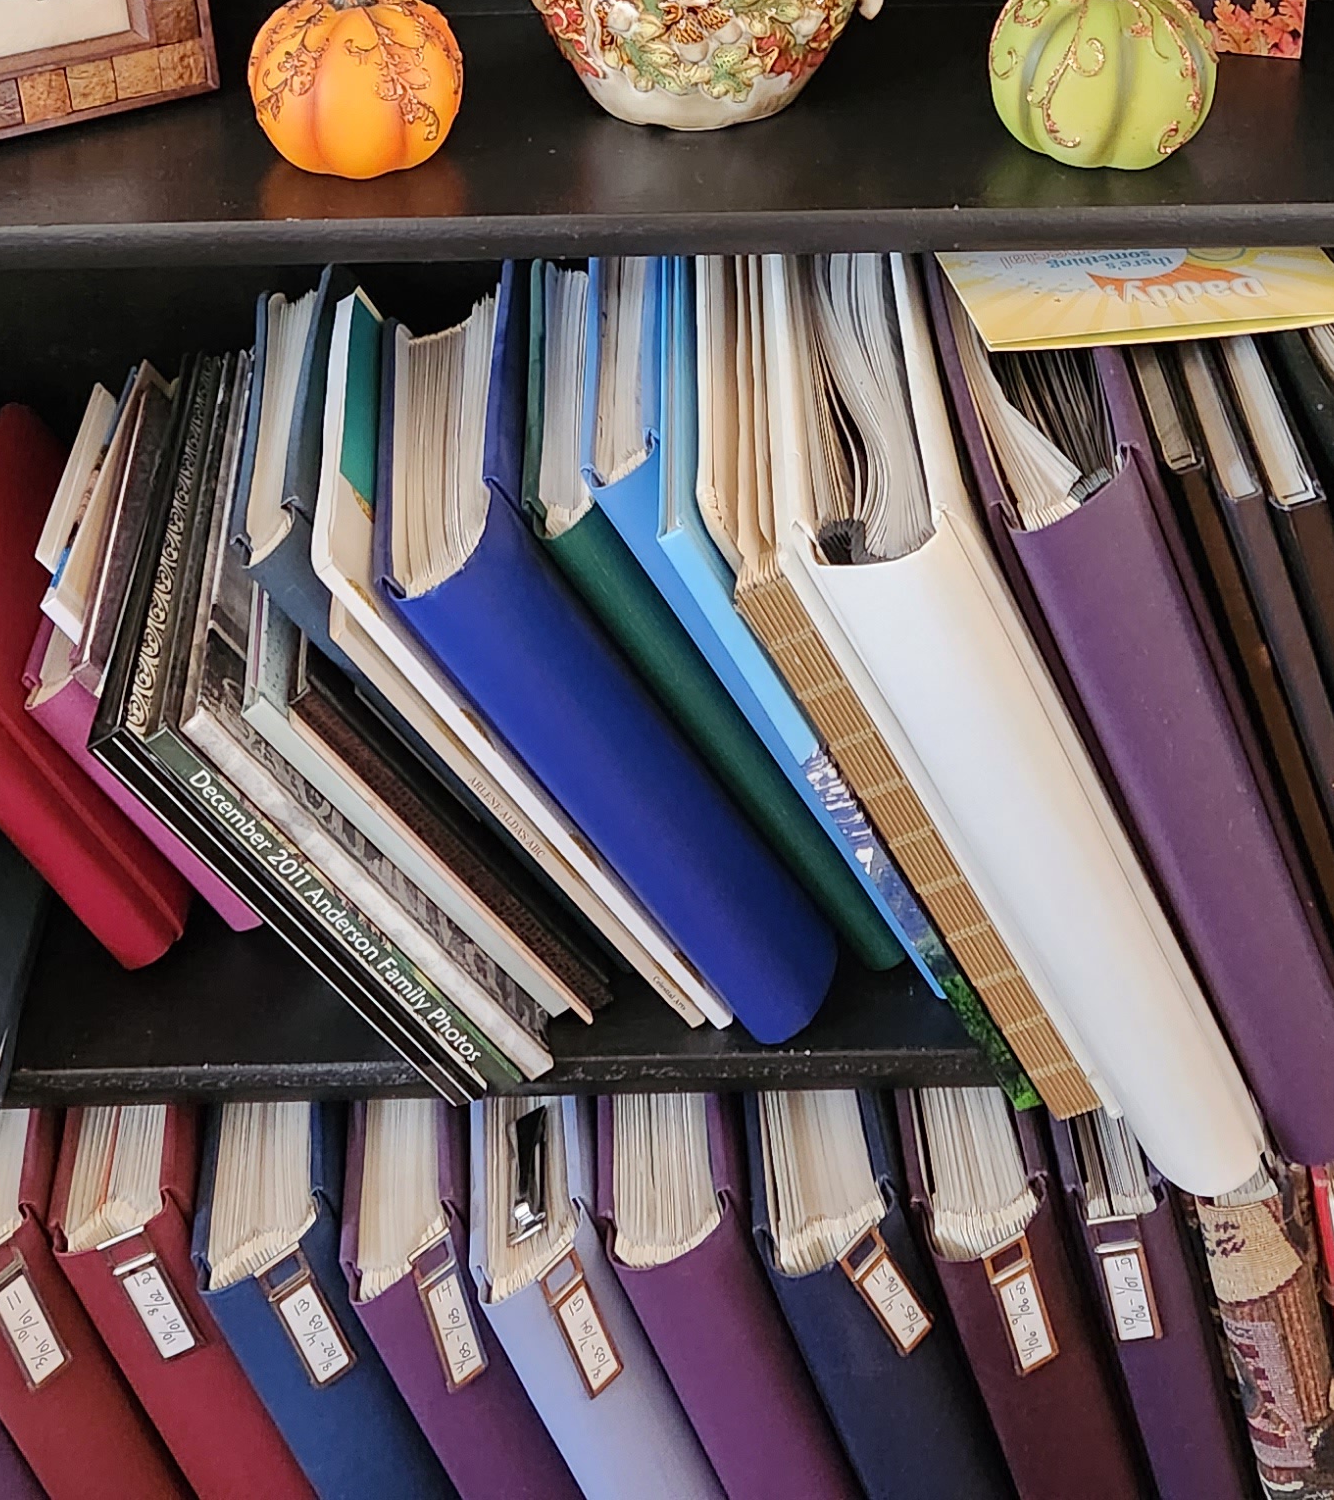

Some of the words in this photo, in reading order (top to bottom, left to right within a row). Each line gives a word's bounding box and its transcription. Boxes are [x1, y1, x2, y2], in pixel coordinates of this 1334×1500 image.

[1046, 251, 1151, 270] something
[1105, 256, 1174, 270] there's
[1104, 277, 1269, 309] Daddy,
[468, 777, 503, 812] ARLENE
[500, 811, 529, 840] ALDA'S
[525, 841, 545, 858] ABC
[189, 768, 273, 852] December
[268, 848, 312, 886] 2011
[304, 887, 380, 961] Anderson
[377, 956, 431, 1012] Family
[426, 1007, 481, 1063] Photos
[868, 1263, 891, 1284] 17
[1114, 1257, 1133, 1271] 19
[133, 1268, 155, 1287] 12
[6, 1290, 21, 1310] 11
[432, 1280, 452, 1302] 14
[1008, 1280, 1026, 1301] 18
[293, 1298, 310, 1316] 13
[564, 1294, 584, 1316] 15
